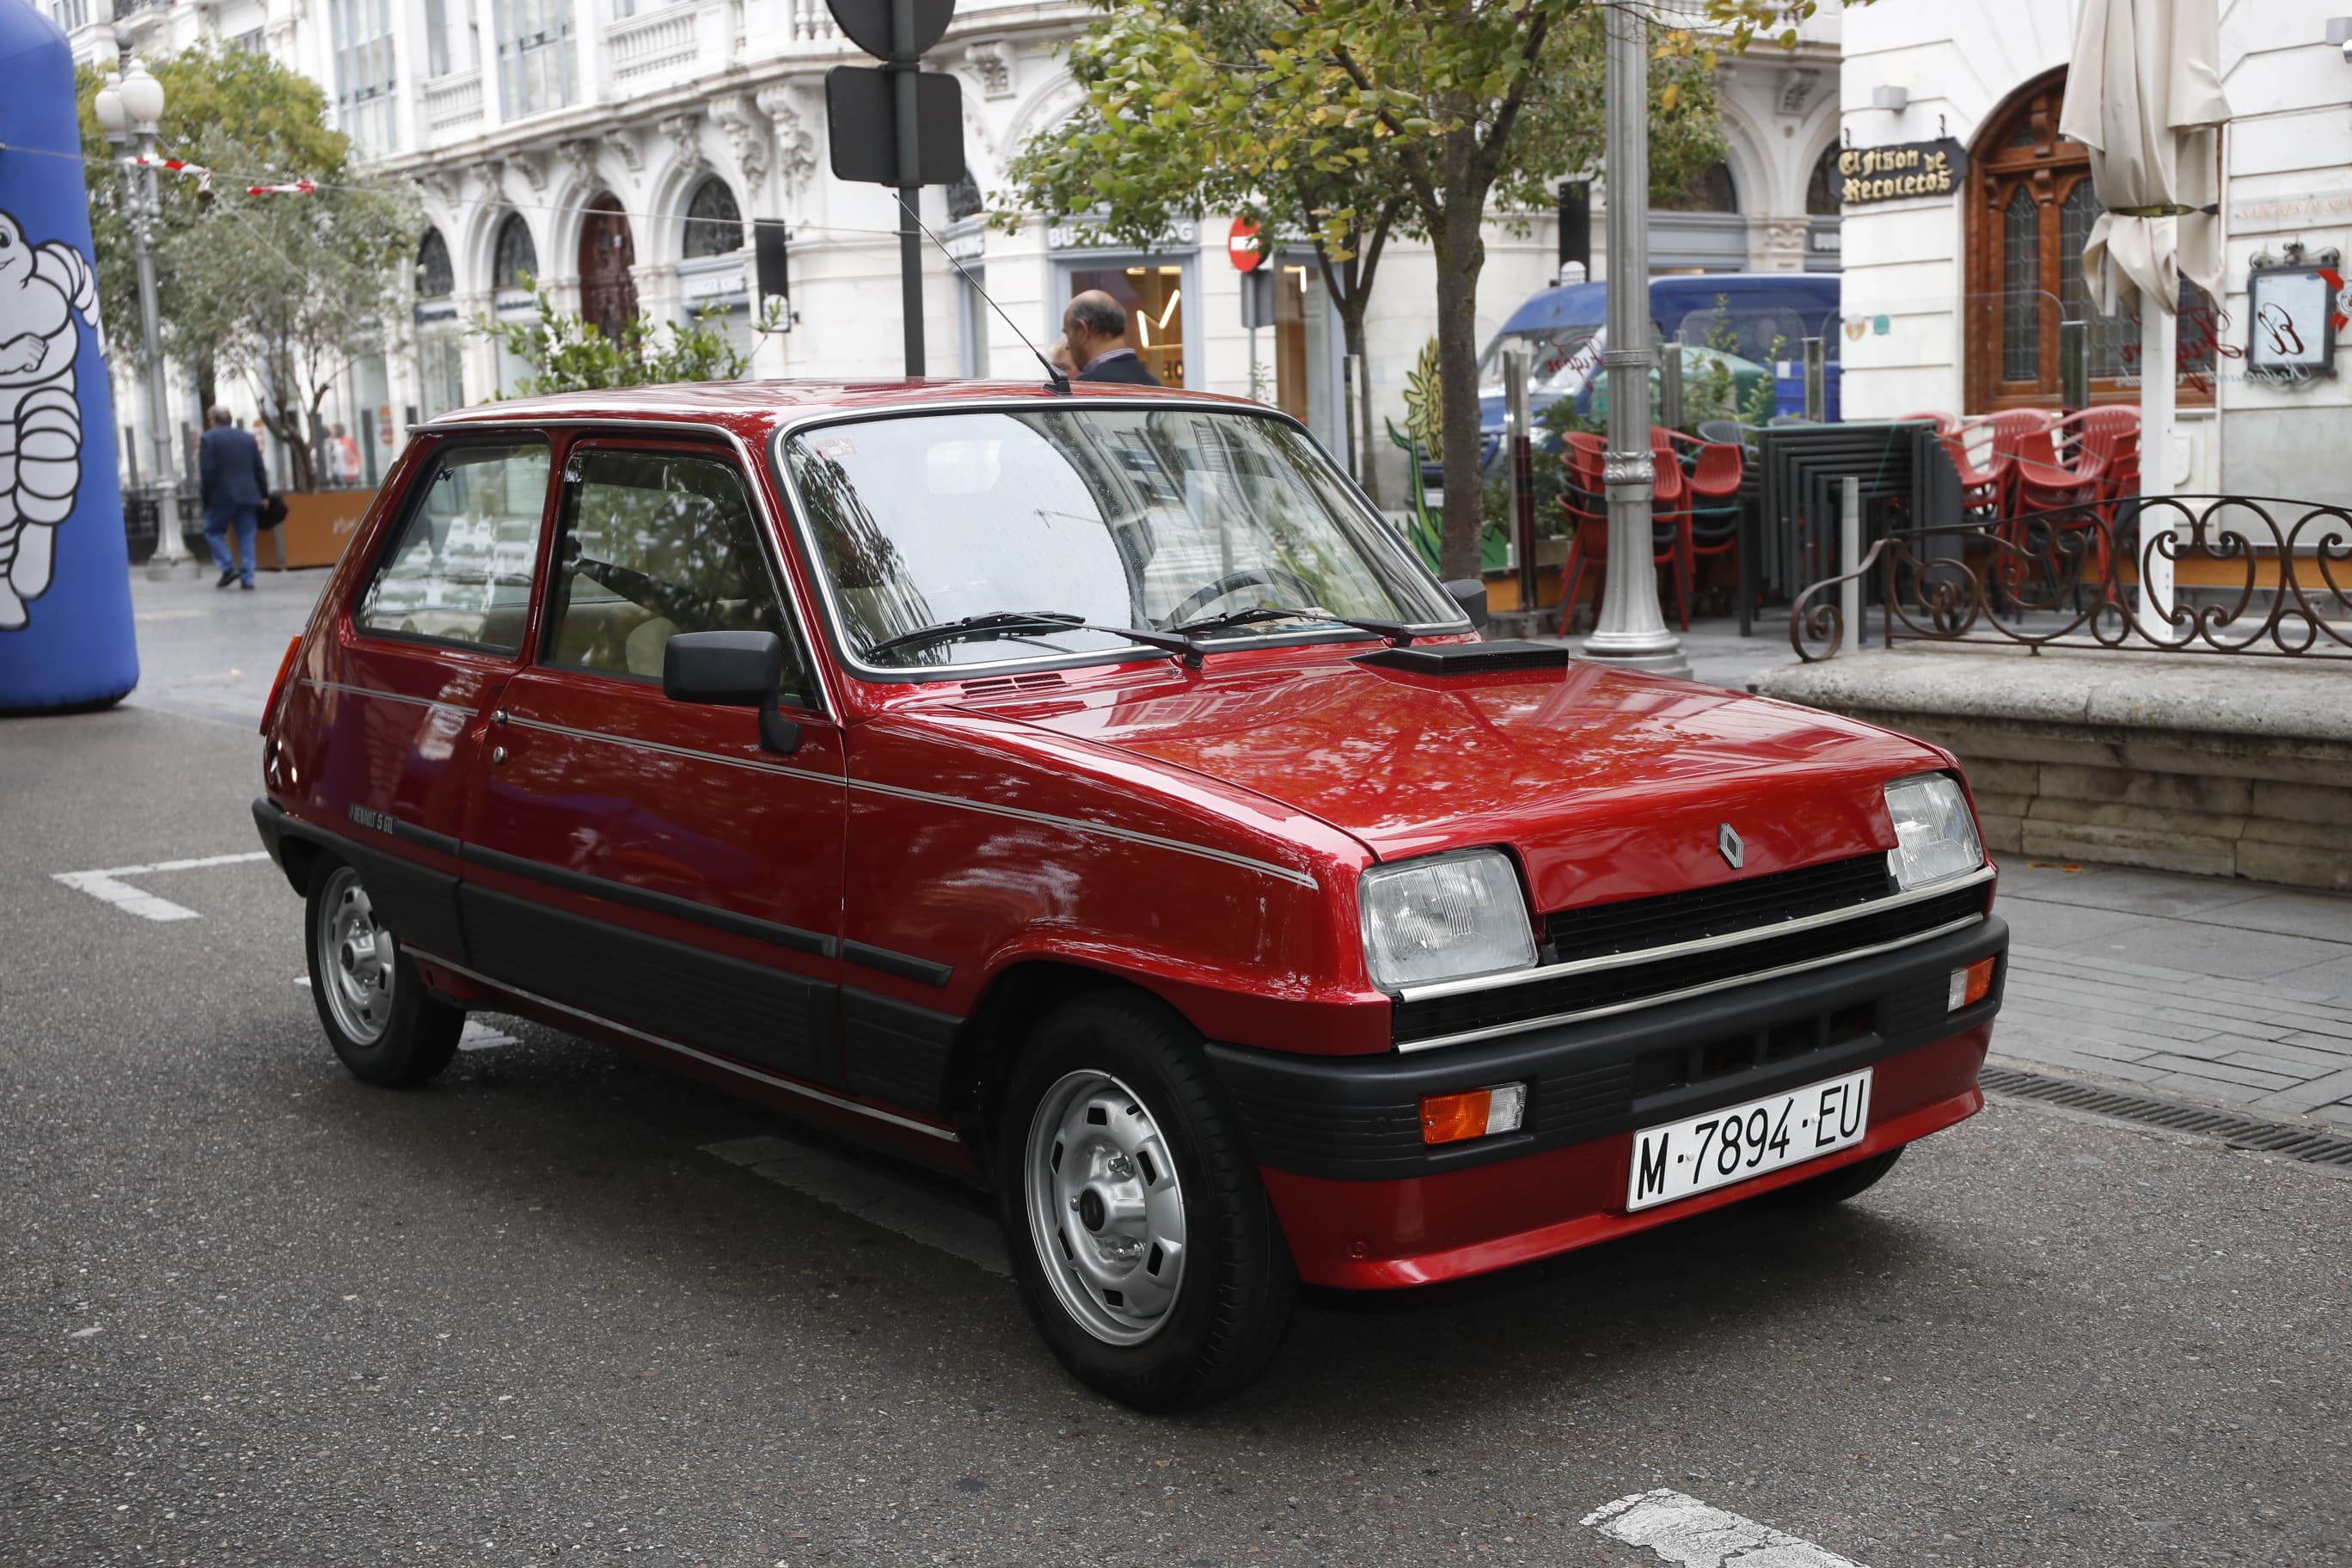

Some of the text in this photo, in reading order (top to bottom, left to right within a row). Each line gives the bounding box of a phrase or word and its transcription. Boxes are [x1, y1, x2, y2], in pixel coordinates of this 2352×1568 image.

[1842, 168, 1953, 202] Recoletos
[353, 805, 393, 834] RENAULT 5 GTL
